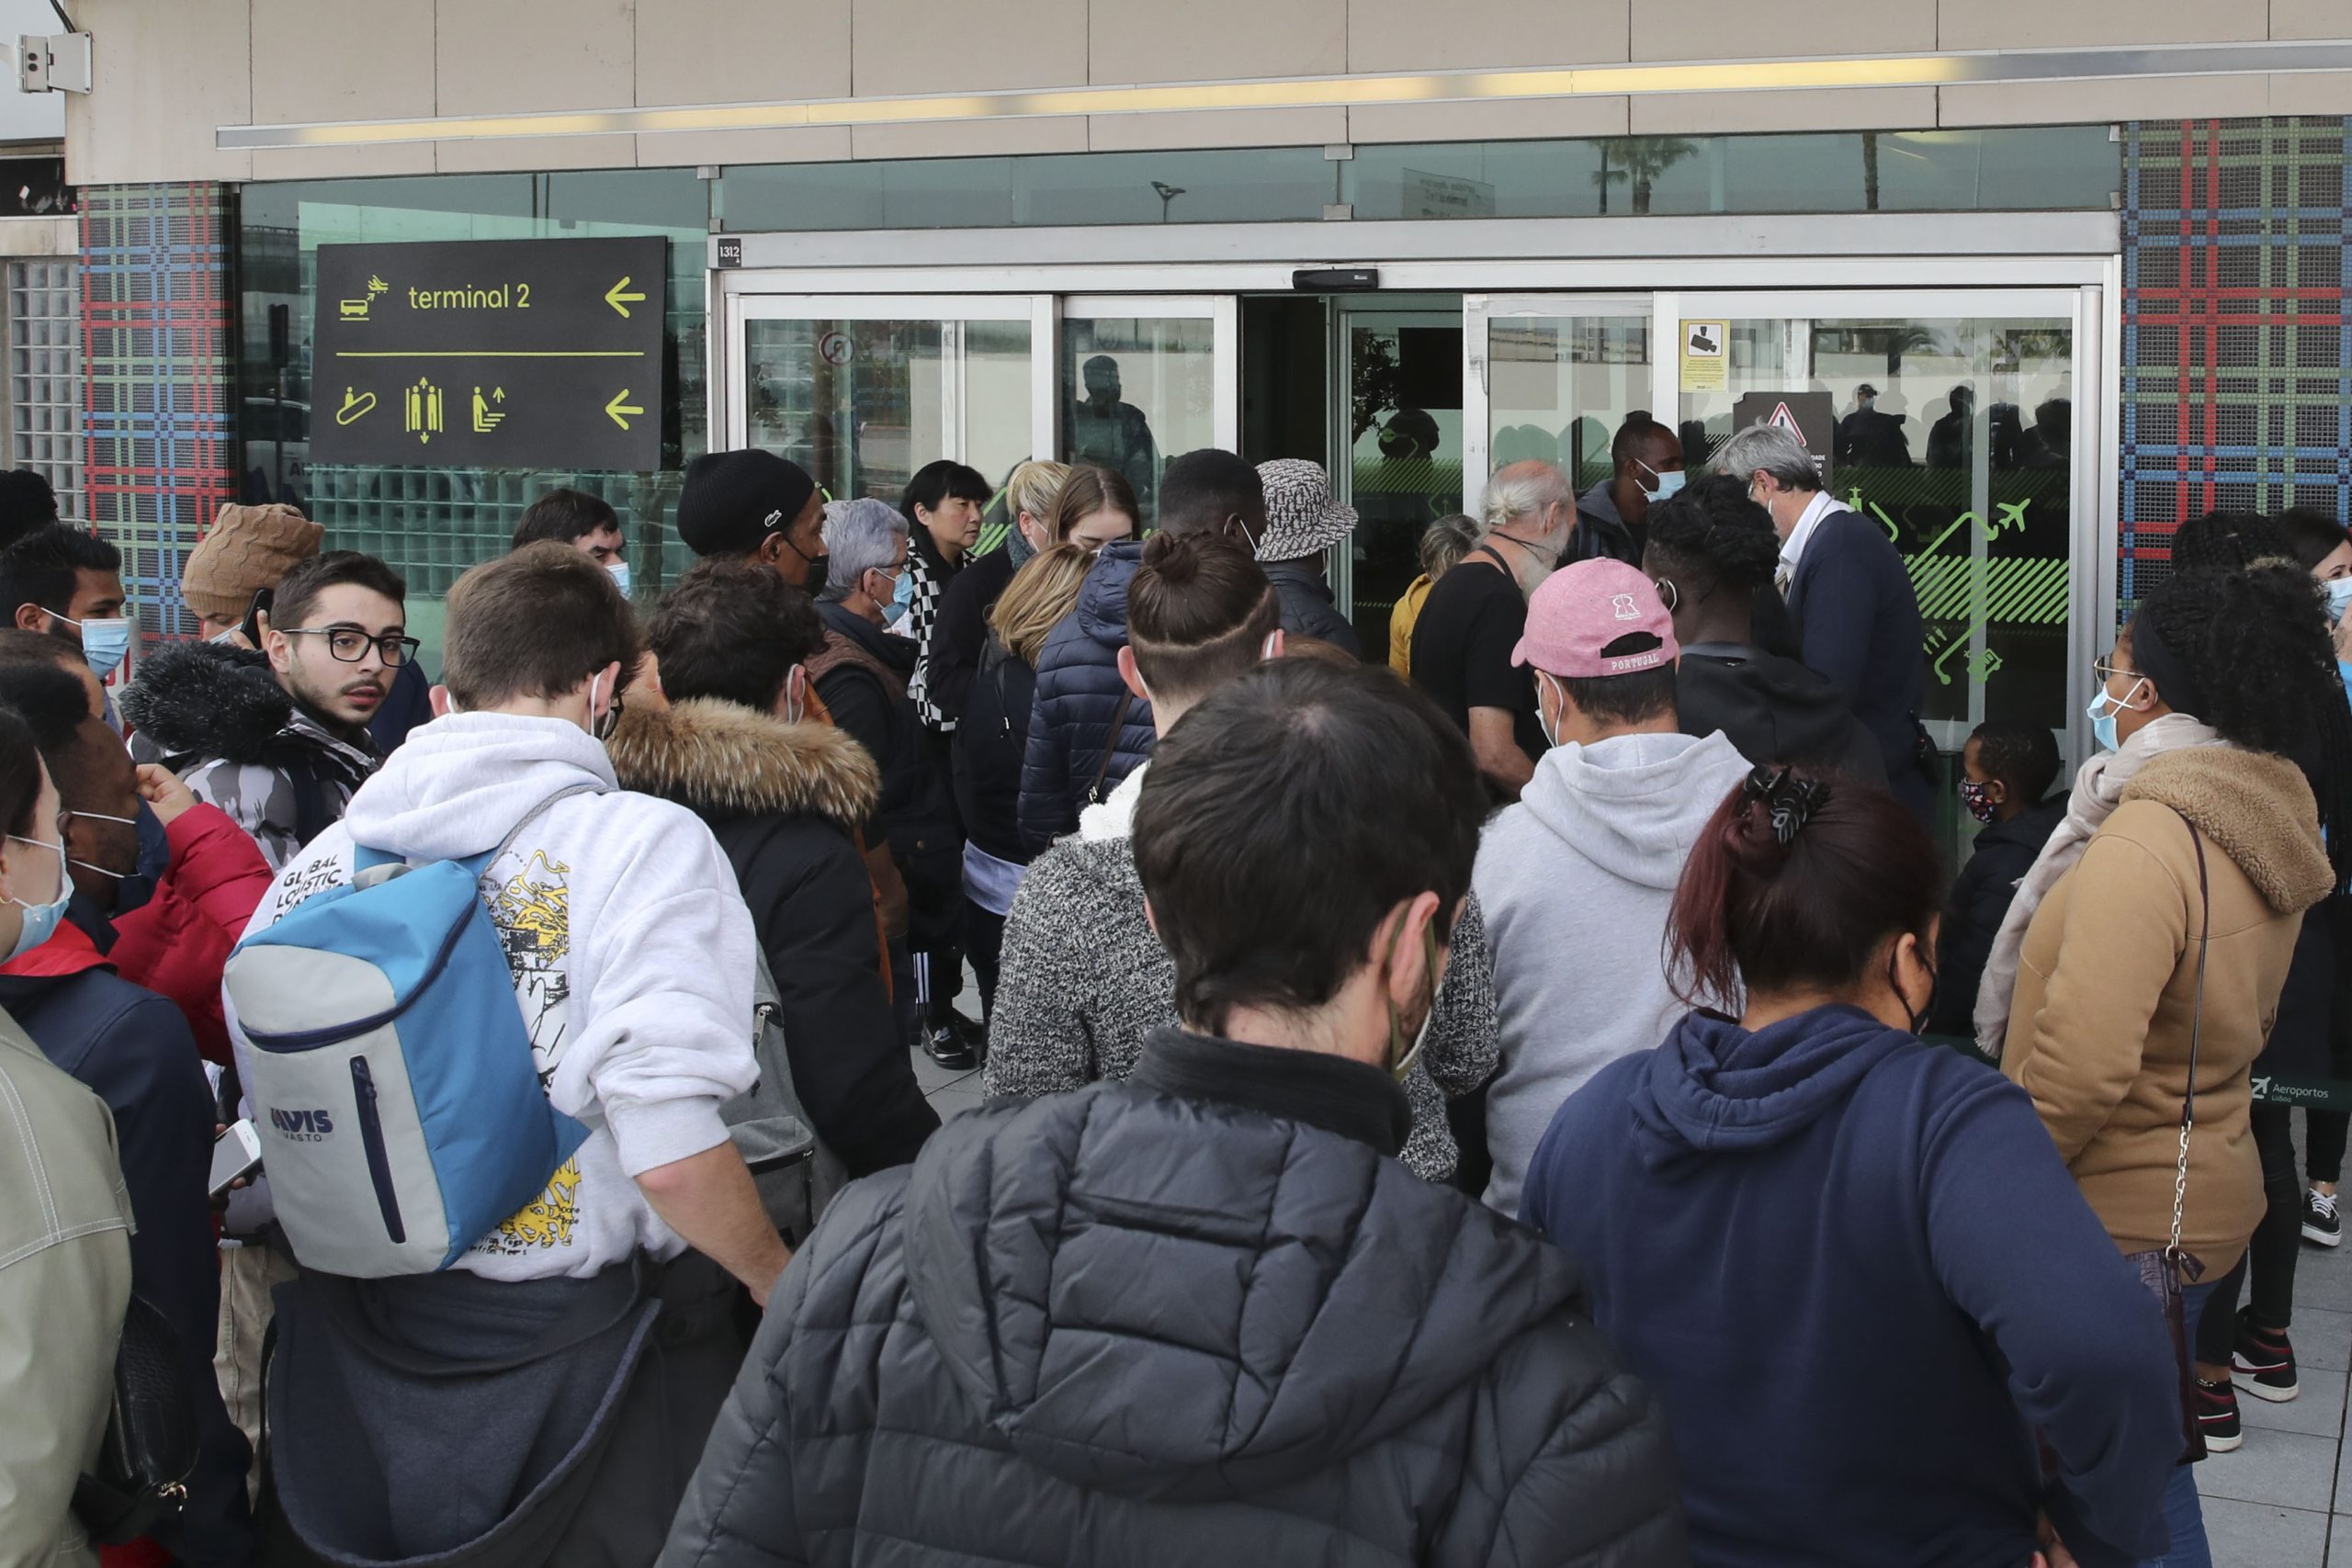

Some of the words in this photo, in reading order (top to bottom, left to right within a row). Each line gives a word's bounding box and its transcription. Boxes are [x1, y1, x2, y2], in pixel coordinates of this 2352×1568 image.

[719, 245, 741, 258] 1312
[408, 283, 510, 310] terminal
[516, 283, 530, 308] 2
[1611, 653, 1659, 671] PORTUGAL
[283, 853, 338, 887] GLBAL
[276, 869, 343, 908] LOISTIC
[2271, 1094, 2292, 1103] Lisboa
[2272, 1083, 2330, 1099] Aeroportos
[270, 1108, 334, 1134] AVIS
